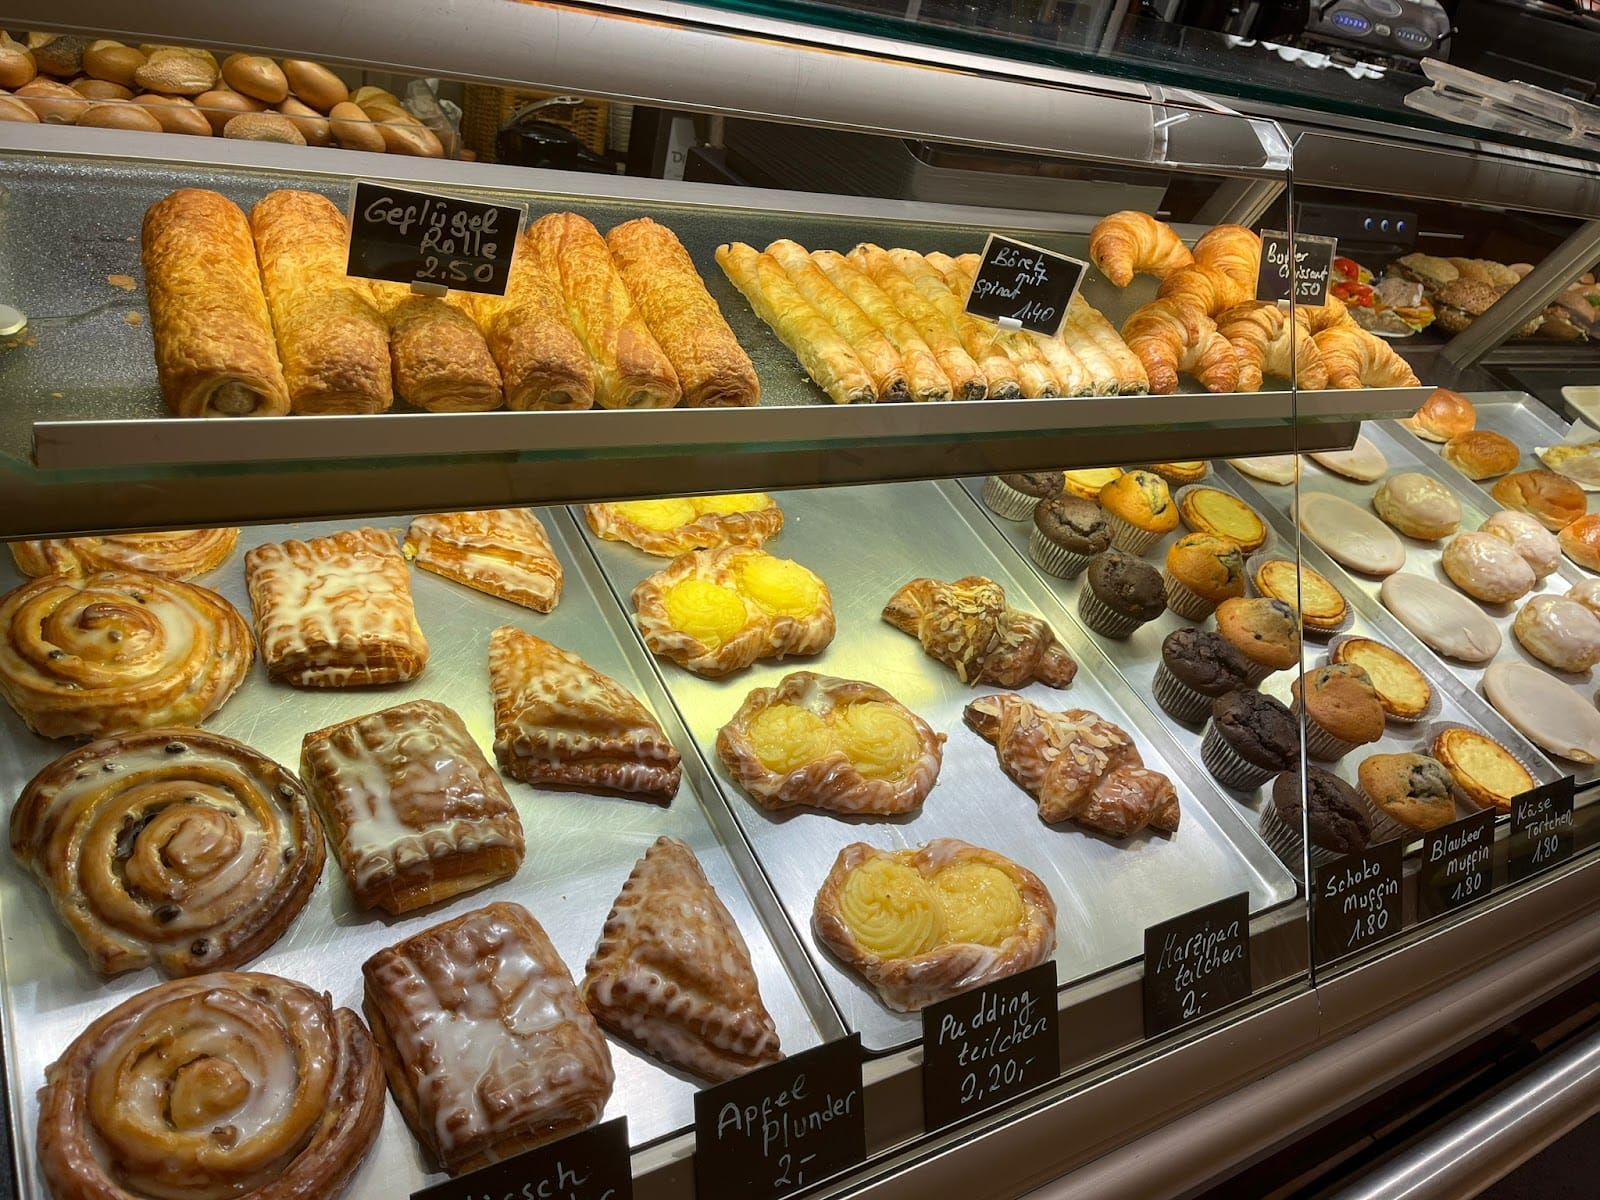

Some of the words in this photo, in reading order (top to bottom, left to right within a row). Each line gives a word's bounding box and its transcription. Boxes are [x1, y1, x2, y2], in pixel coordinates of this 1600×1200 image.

[364, 197, 498, 238] Geflügel
[420, 226, 497, 260] Rolle
[990, 247, 1045, 272] Börek
[1015, 268, 1048, 286] mit
[1516, 797, 1553, 825] Käse
[1430, 825, 1484, 862] Blaubeer
[1324, 859, 1380, 898] Schoko
[717, 1074, 806, 1140] Apfel
